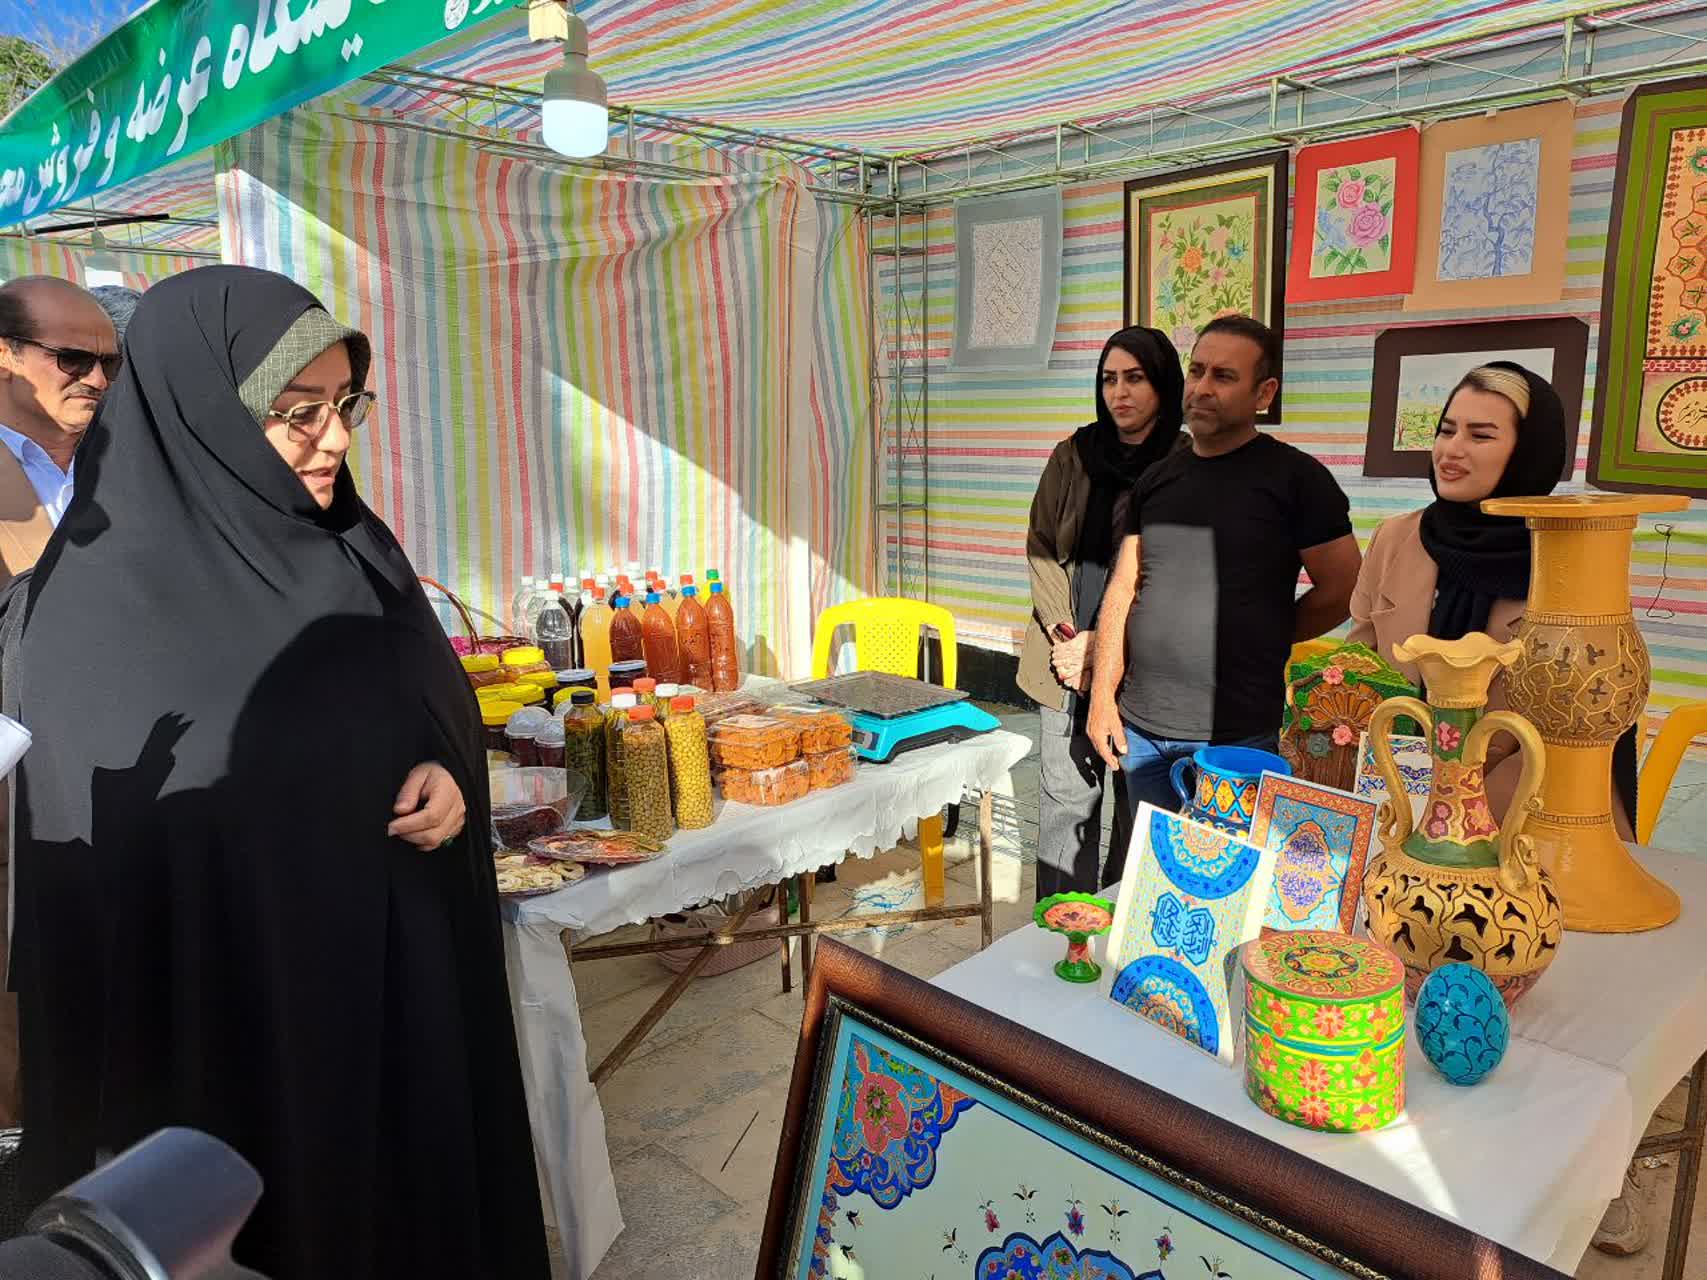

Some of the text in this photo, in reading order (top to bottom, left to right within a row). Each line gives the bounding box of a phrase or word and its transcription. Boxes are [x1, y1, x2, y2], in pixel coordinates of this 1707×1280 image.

[22, 87, 101, 216] فروش
[95, 115, 121, 188] و
[126, 35, 212, 157] عرضه
